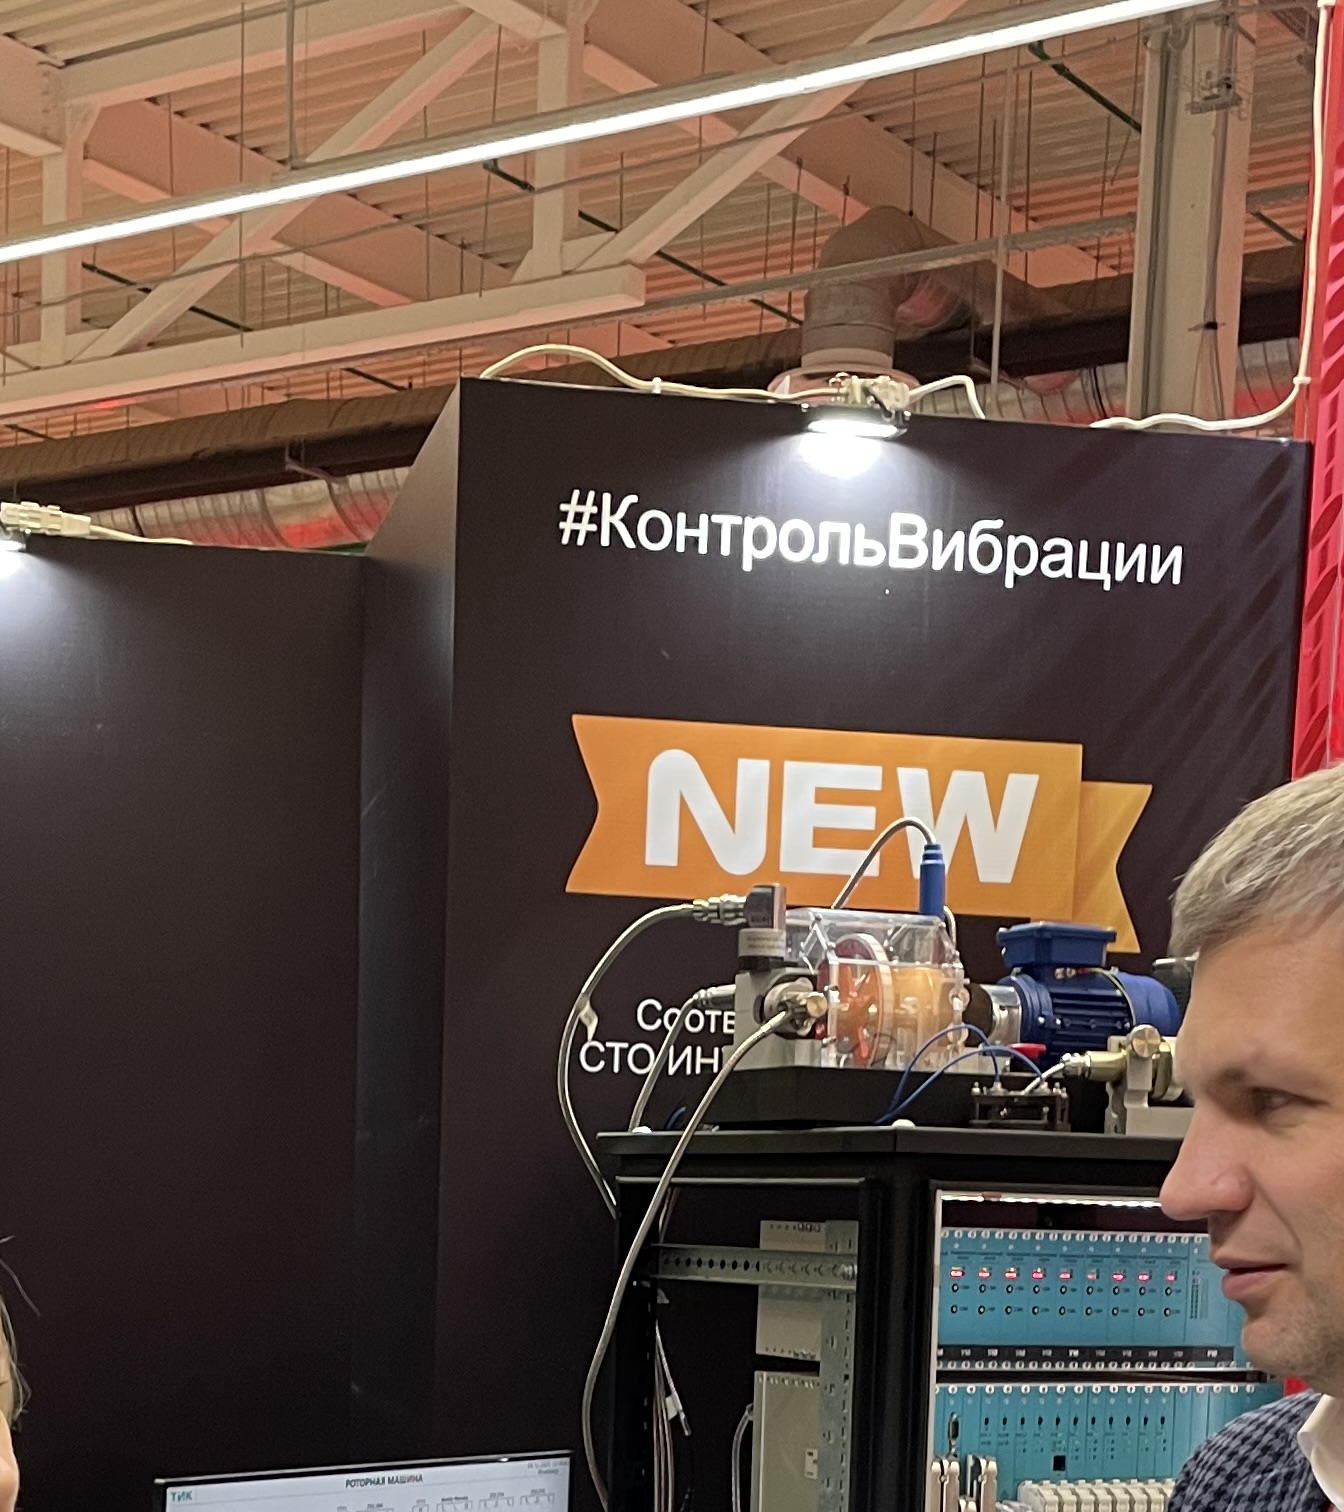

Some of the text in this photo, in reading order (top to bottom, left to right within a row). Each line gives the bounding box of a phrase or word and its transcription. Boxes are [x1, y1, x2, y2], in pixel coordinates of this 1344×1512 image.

[560, 489, 1184, 591] #КонтрольВибрации
[645, 749, 1038, 884] NEW
[579, 1041, 655, 1075] СТО
